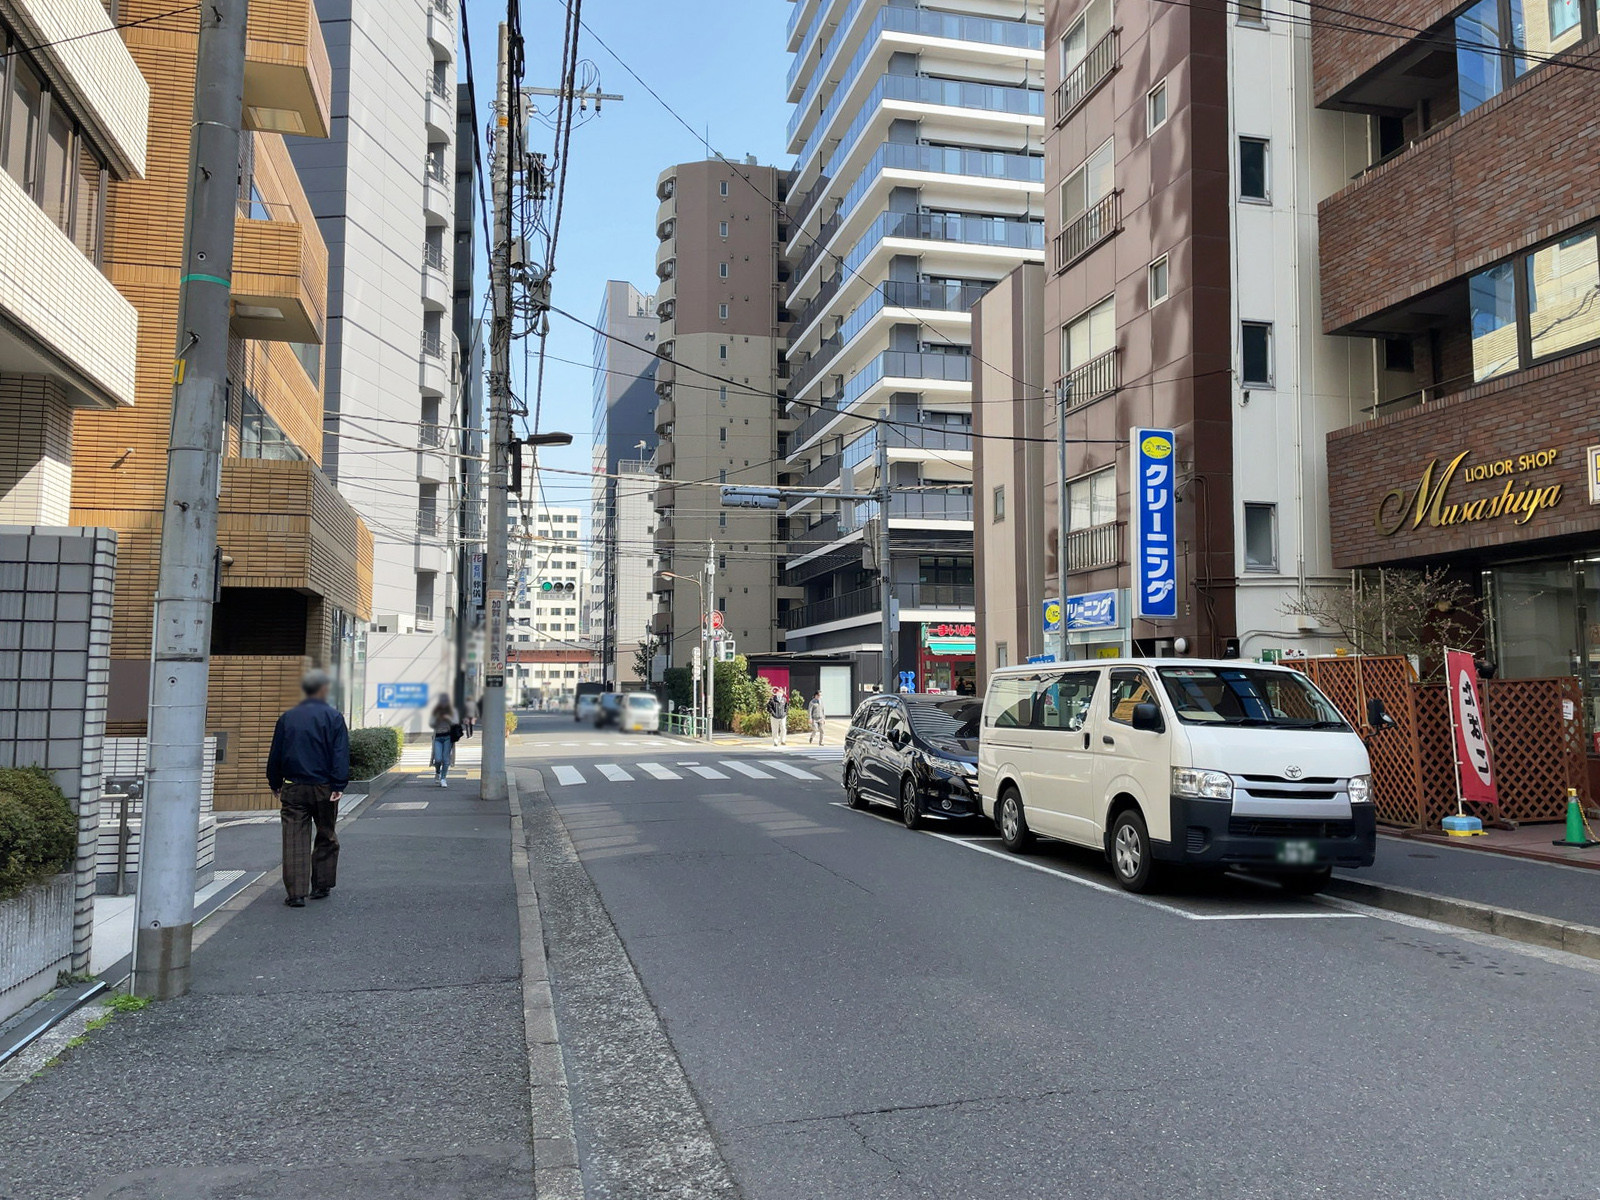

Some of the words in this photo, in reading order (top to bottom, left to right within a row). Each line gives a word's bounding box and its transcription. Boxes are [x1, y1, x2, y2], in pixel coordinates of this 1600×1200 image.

[1374, 450, 1563, 536] Musashiya
[1465, 459, 1514, 483] LIQUOR
[1518, 449, 1558, 471] SHOP
[1145, 464, 1174, 604] クリーニング
[1066, 597, 1113, 619] リーニング
